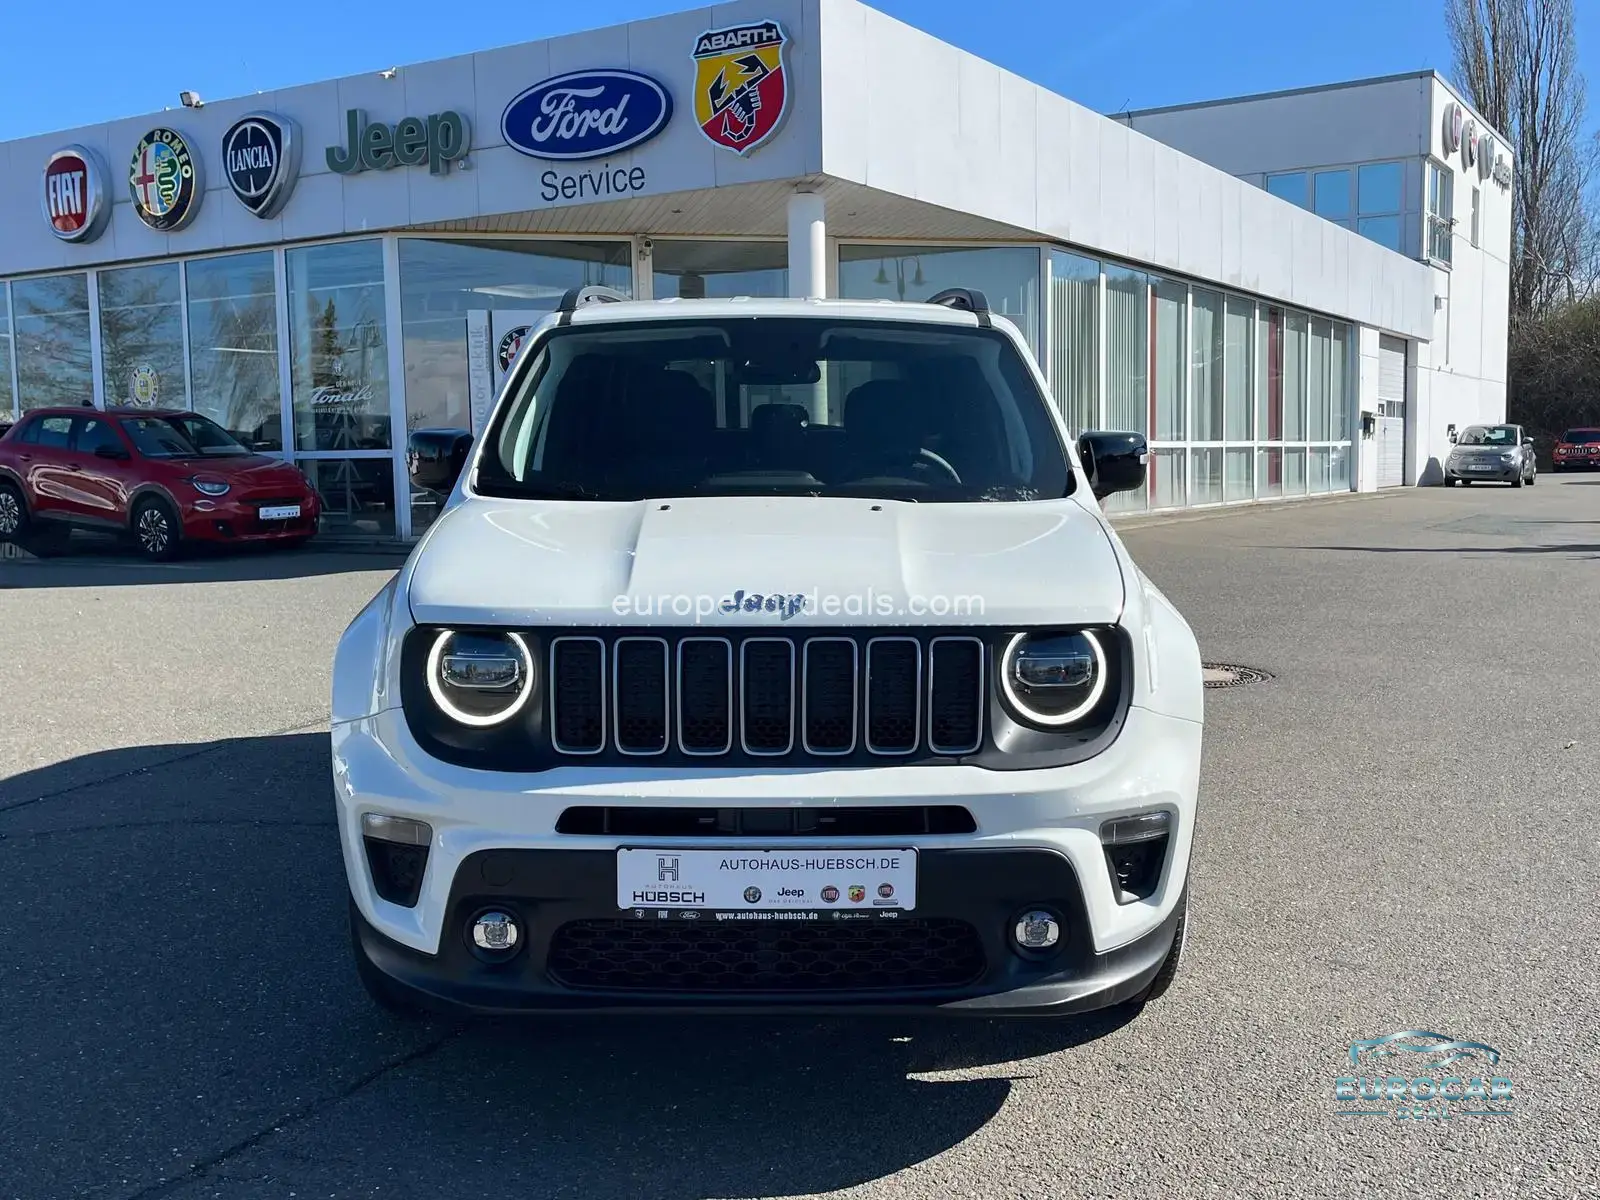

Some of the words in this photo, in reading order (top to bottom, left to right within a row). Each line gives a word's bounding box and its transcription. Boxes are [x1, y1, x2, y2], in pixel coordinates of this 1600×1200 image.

[699, 28, 777, 53] ABARTH
[531, 85, 631, 142] Ford
[325, 108, 468, 176] Jeep
[130, 139, 150, 185] ALFA
[154, 130, 192, 178] ROMEO
[231, 144, 272, 173] LANCIA
[48, 171, 84, 217] FIAT
[540, 163, 646, 202] Service
[500, 332, 519, 358] ALFA
[310, 385, 375, 405] Tonale
[719, 858, 900, 870] AUTOHAUS-HUEBSCH.DE
[633, 891, 705, 903] HÜBSCH
[777, 887, 805, 898] Jeep
[715, 911, 819, 920] www.autohaus-huebsch.de
[879, 911, 898, 919] Jeep
